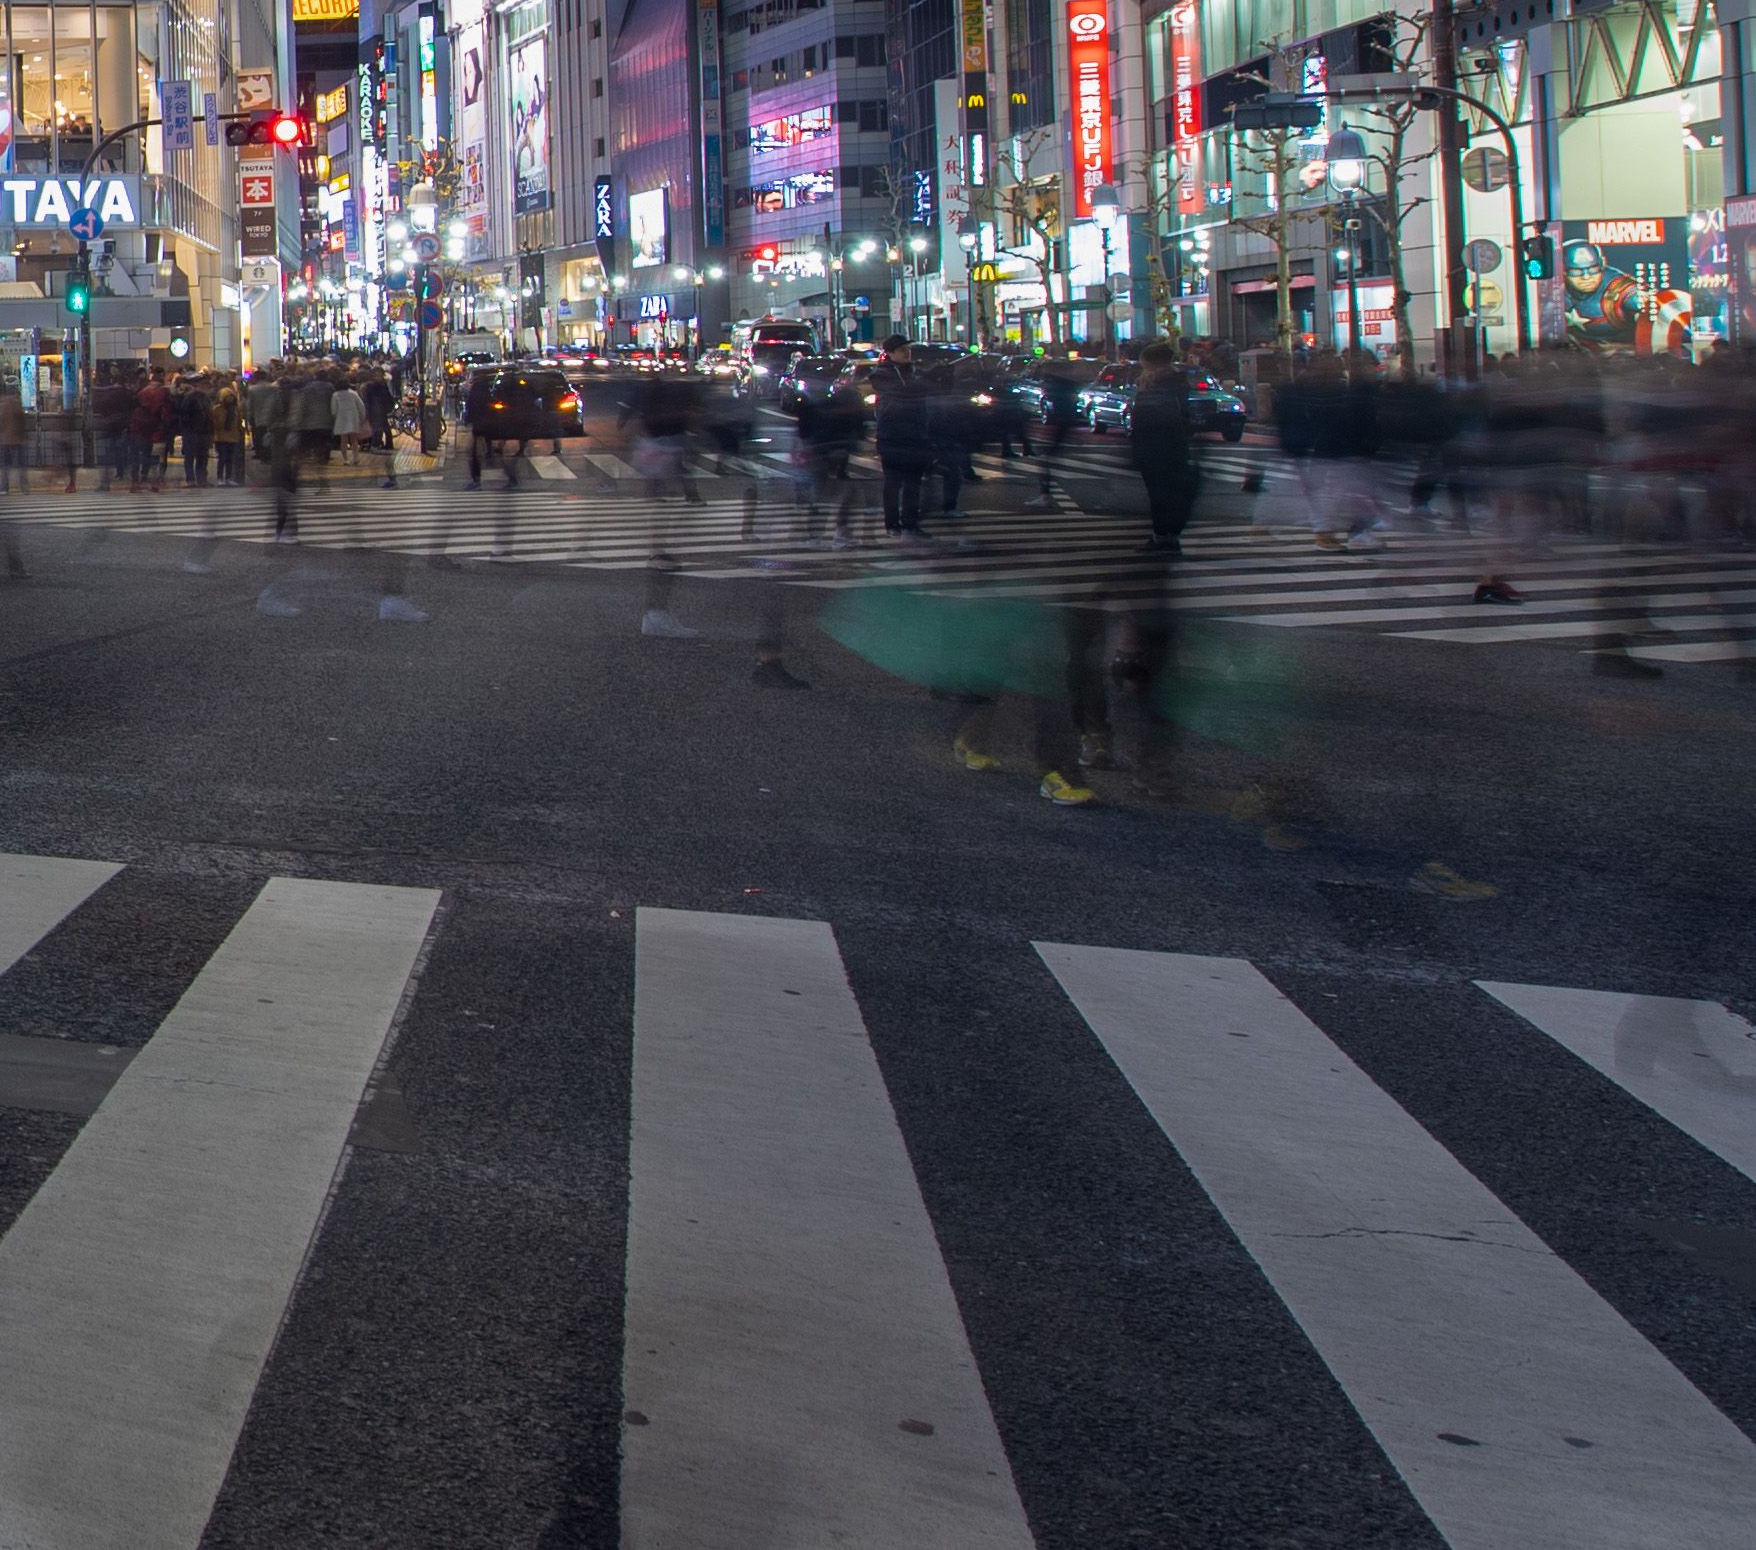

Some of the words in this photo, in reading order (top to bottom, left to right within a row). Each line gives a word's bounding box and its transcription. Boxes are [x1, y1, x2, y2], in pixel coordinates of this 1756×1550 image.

[173, 87, 189, 144] 渋谷駅前
[358, 62, 375, 141] KARAOKE
[246, 179, 268, 200] 本
[942, 135, 962, 227] 大和証券
[597, 185, 612, 237] ZARA
[1589, 221, 1661, 244] MARVEL
[640, 295, 668, 318] ZARA
